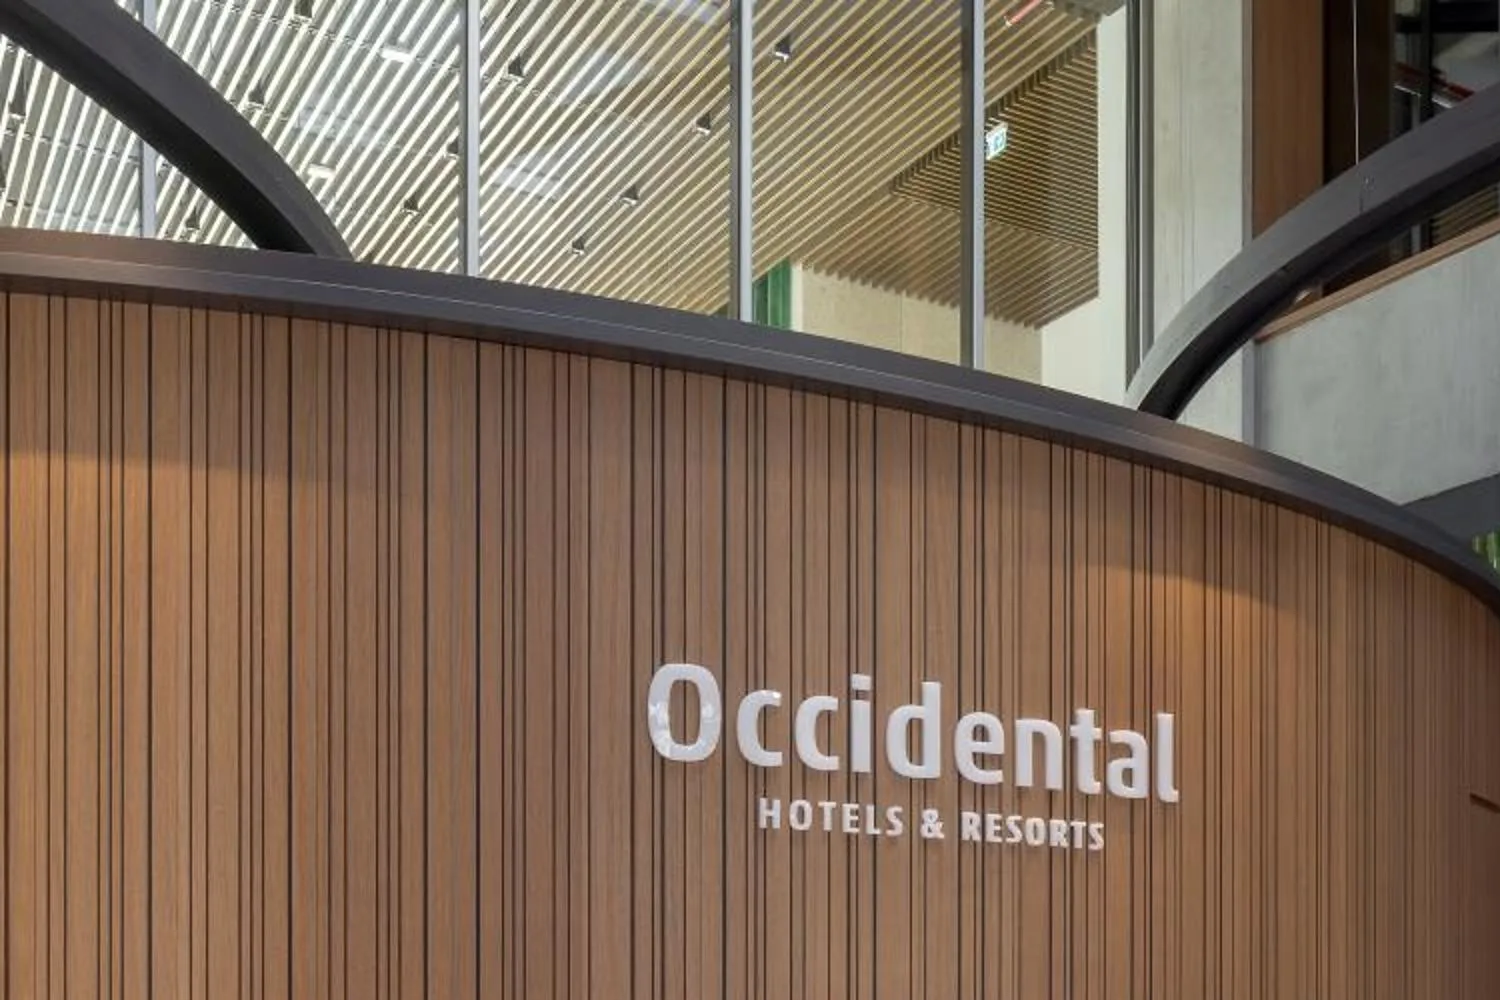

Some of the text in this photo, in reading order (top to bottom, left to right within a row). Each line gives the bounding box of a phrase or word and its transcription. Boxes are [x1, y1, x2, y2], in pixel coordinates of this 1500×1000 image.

[647, 662, 1179, 803] Occidental
[758, 797, 1106, 851] HOTELS & RESORTS
